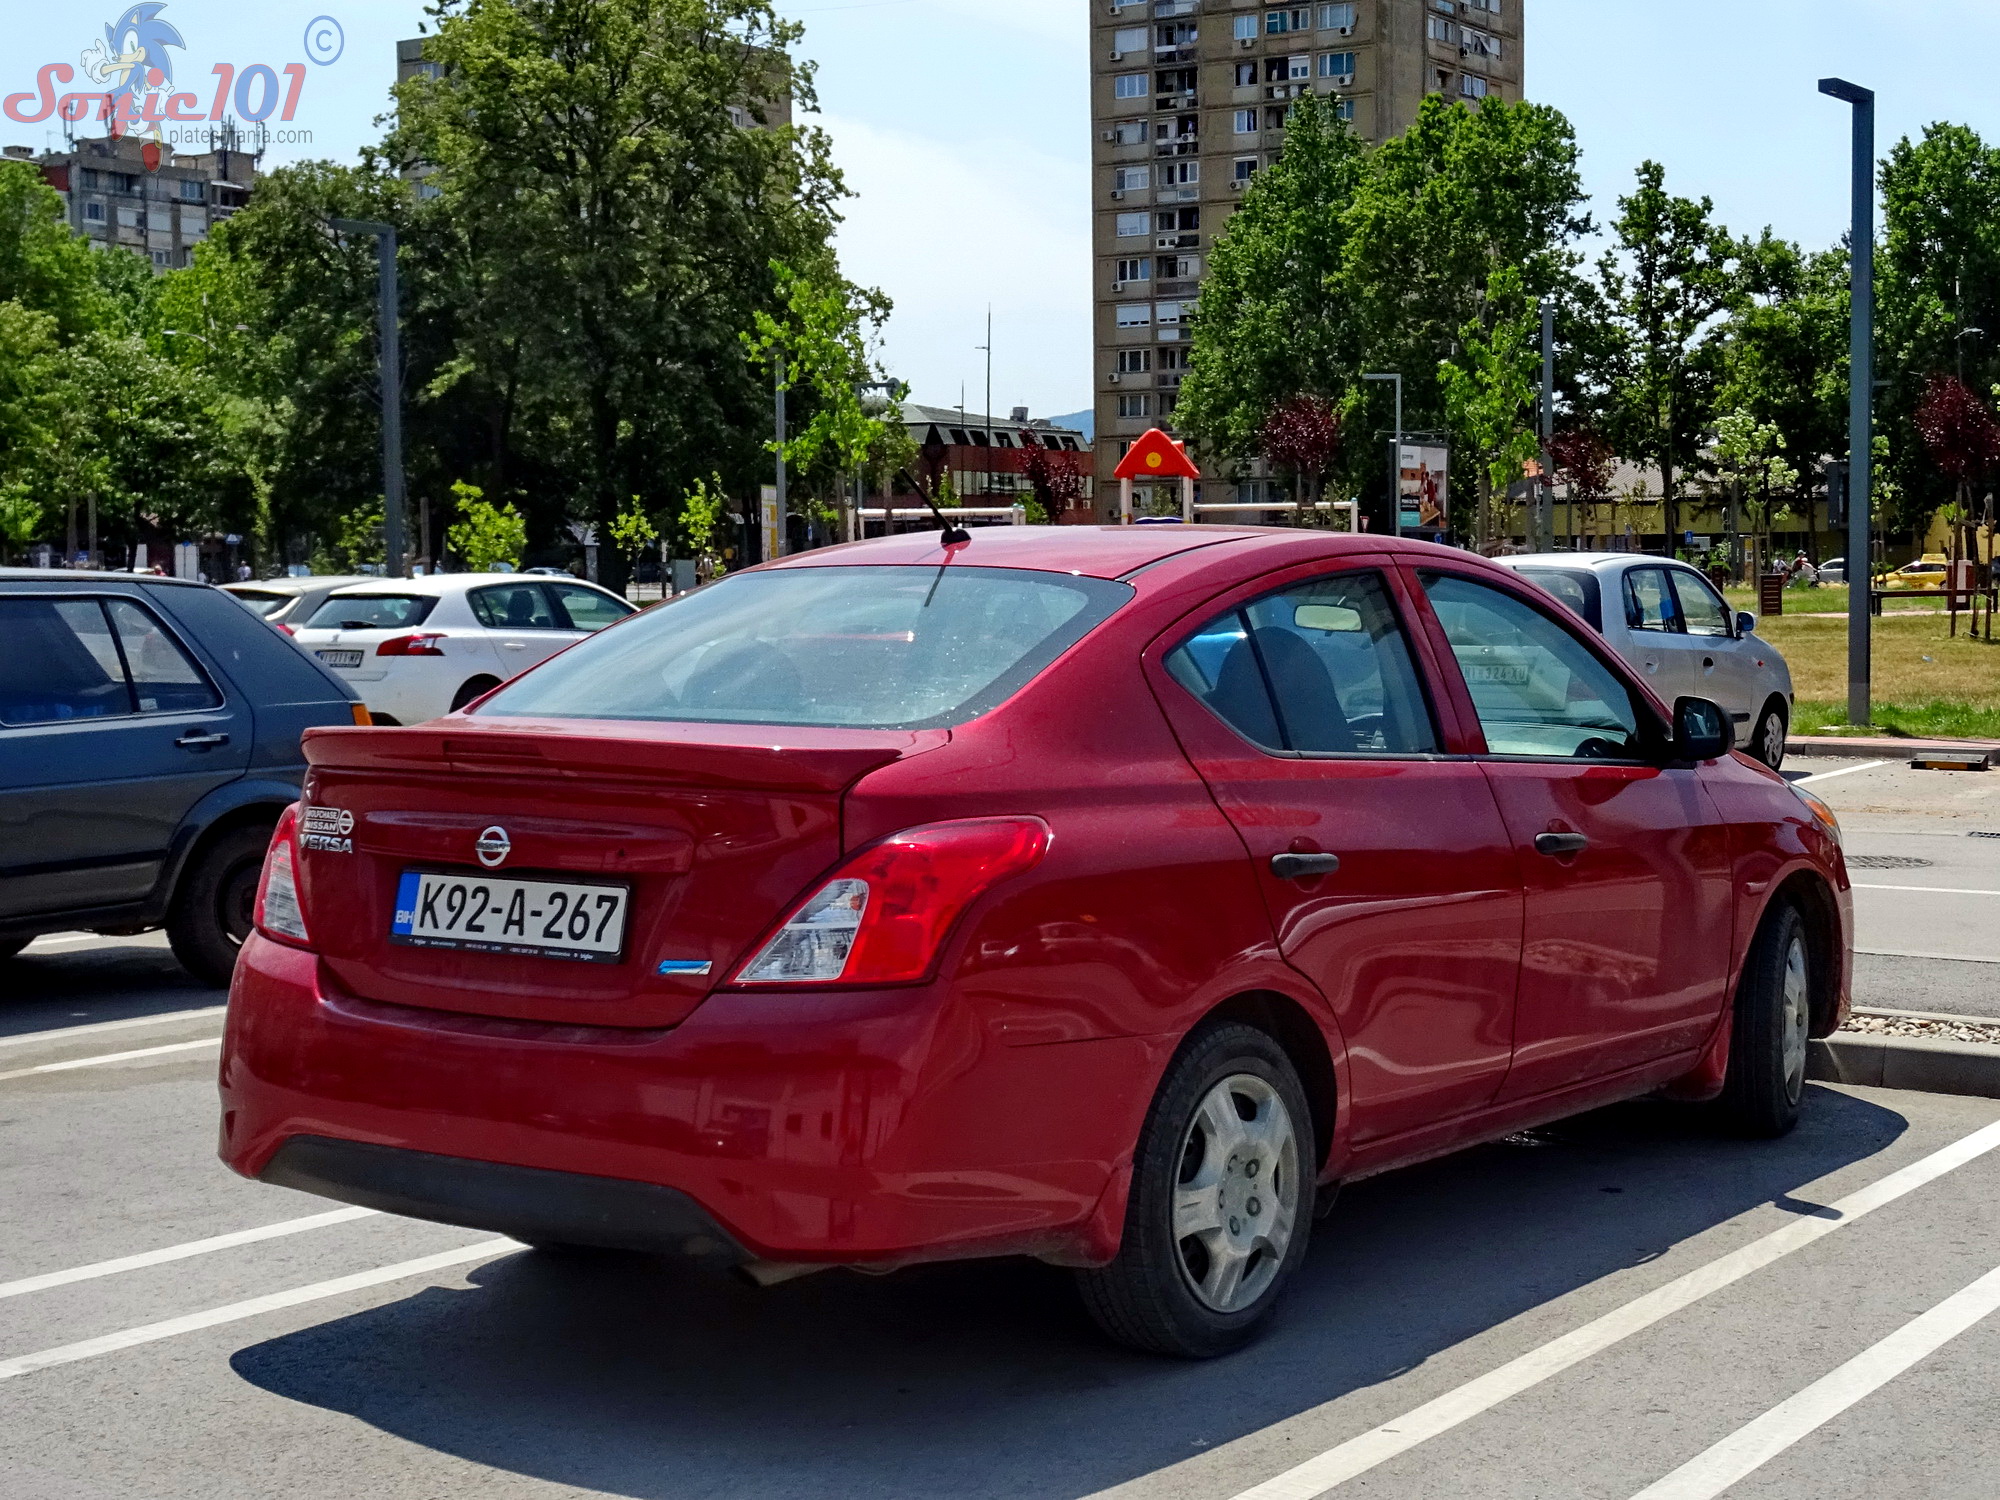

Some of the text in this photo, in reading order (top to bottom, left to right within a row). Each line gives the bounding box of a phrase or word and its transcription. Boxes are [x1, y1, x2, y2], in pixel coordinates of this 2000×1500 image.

[303, 820, 338, 831] NISSAN
[299, 833, 353, 854] VERSA
[395, 881, 620, 943] BIH K92-A-267
